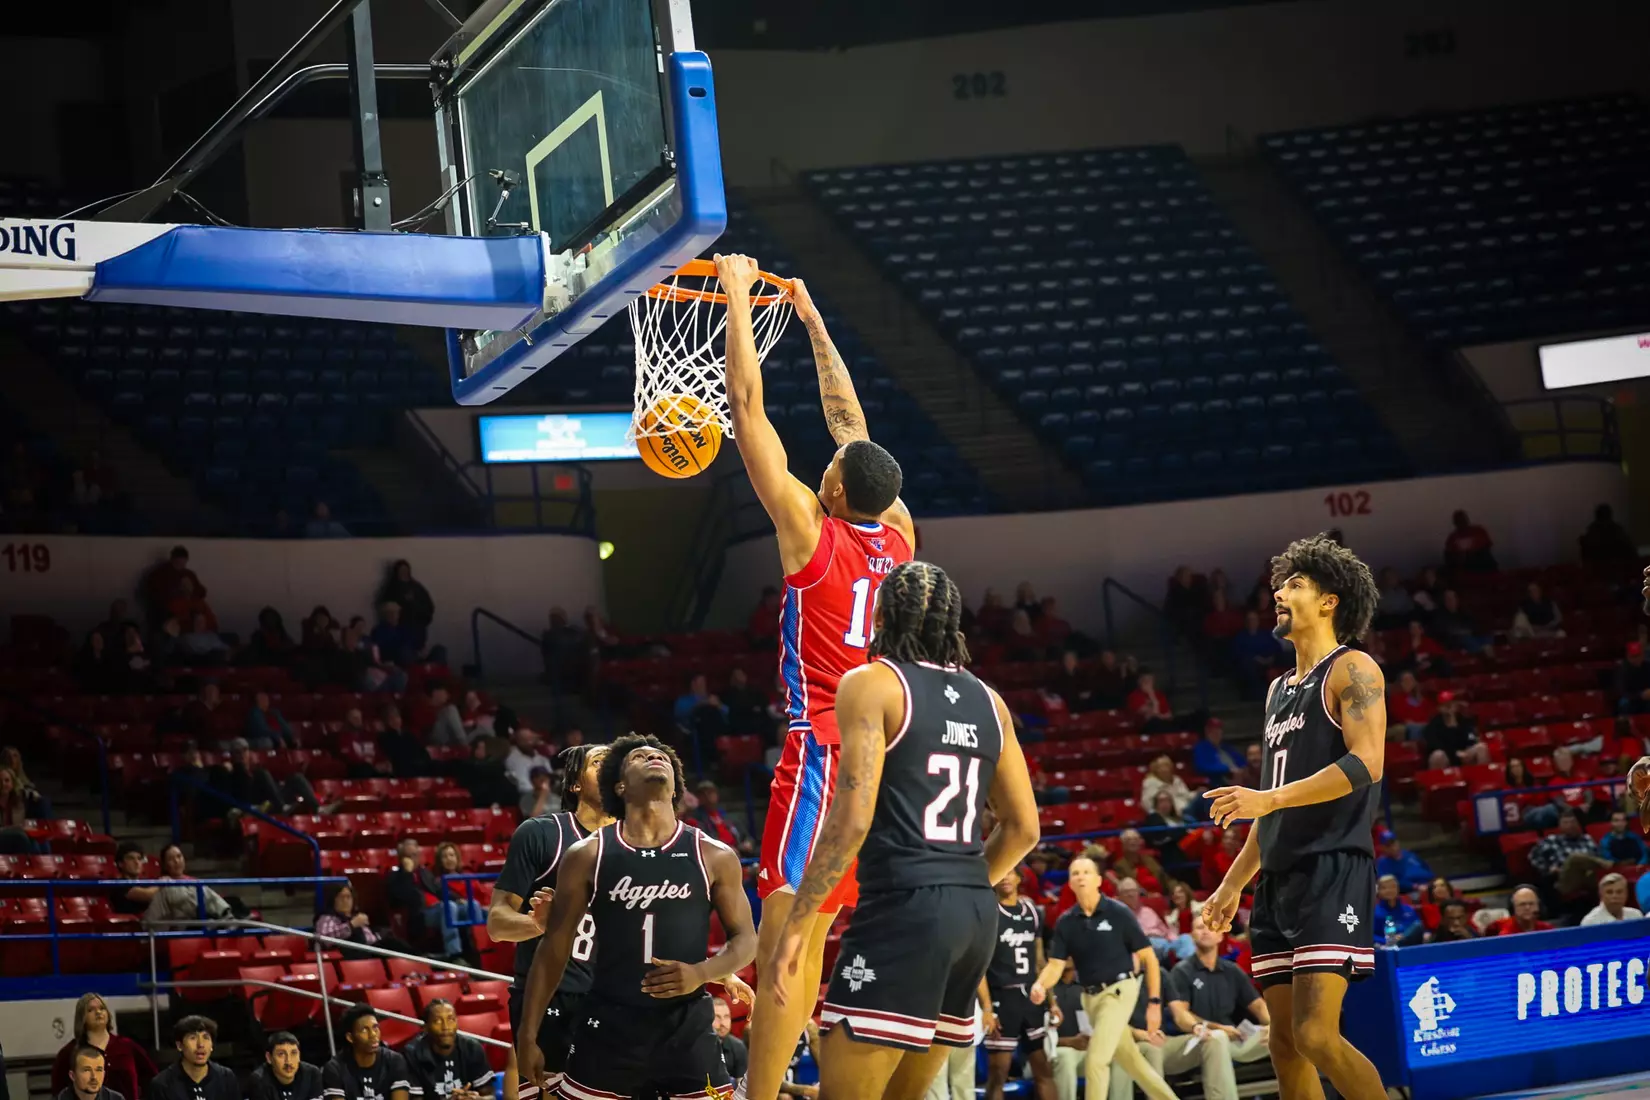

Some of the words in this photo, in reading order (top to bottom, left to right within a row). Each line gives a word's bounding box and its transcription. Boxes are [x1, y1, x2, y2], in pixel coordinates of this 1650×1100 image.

[951, 71, 1007, 100] 202
[656, 421, 689, 471] Wilson
[1324, 490, 1372, 517] 102
[2, 543, 51, 573] 119
[843, 576, 880, 649] 1
[941, 719, 978, 749] JONES
[1264, 712, 1306, 749] Aggies
[923, 752, 982, 845] 21
[608, 875, 692, 910] Aggies
[571, 912, 597, 962] 8
[641, 912, 655, 964] 1
[1014, 946, 1030, 975] 5
[1517, 957, 1645, 1021] PROTEC
